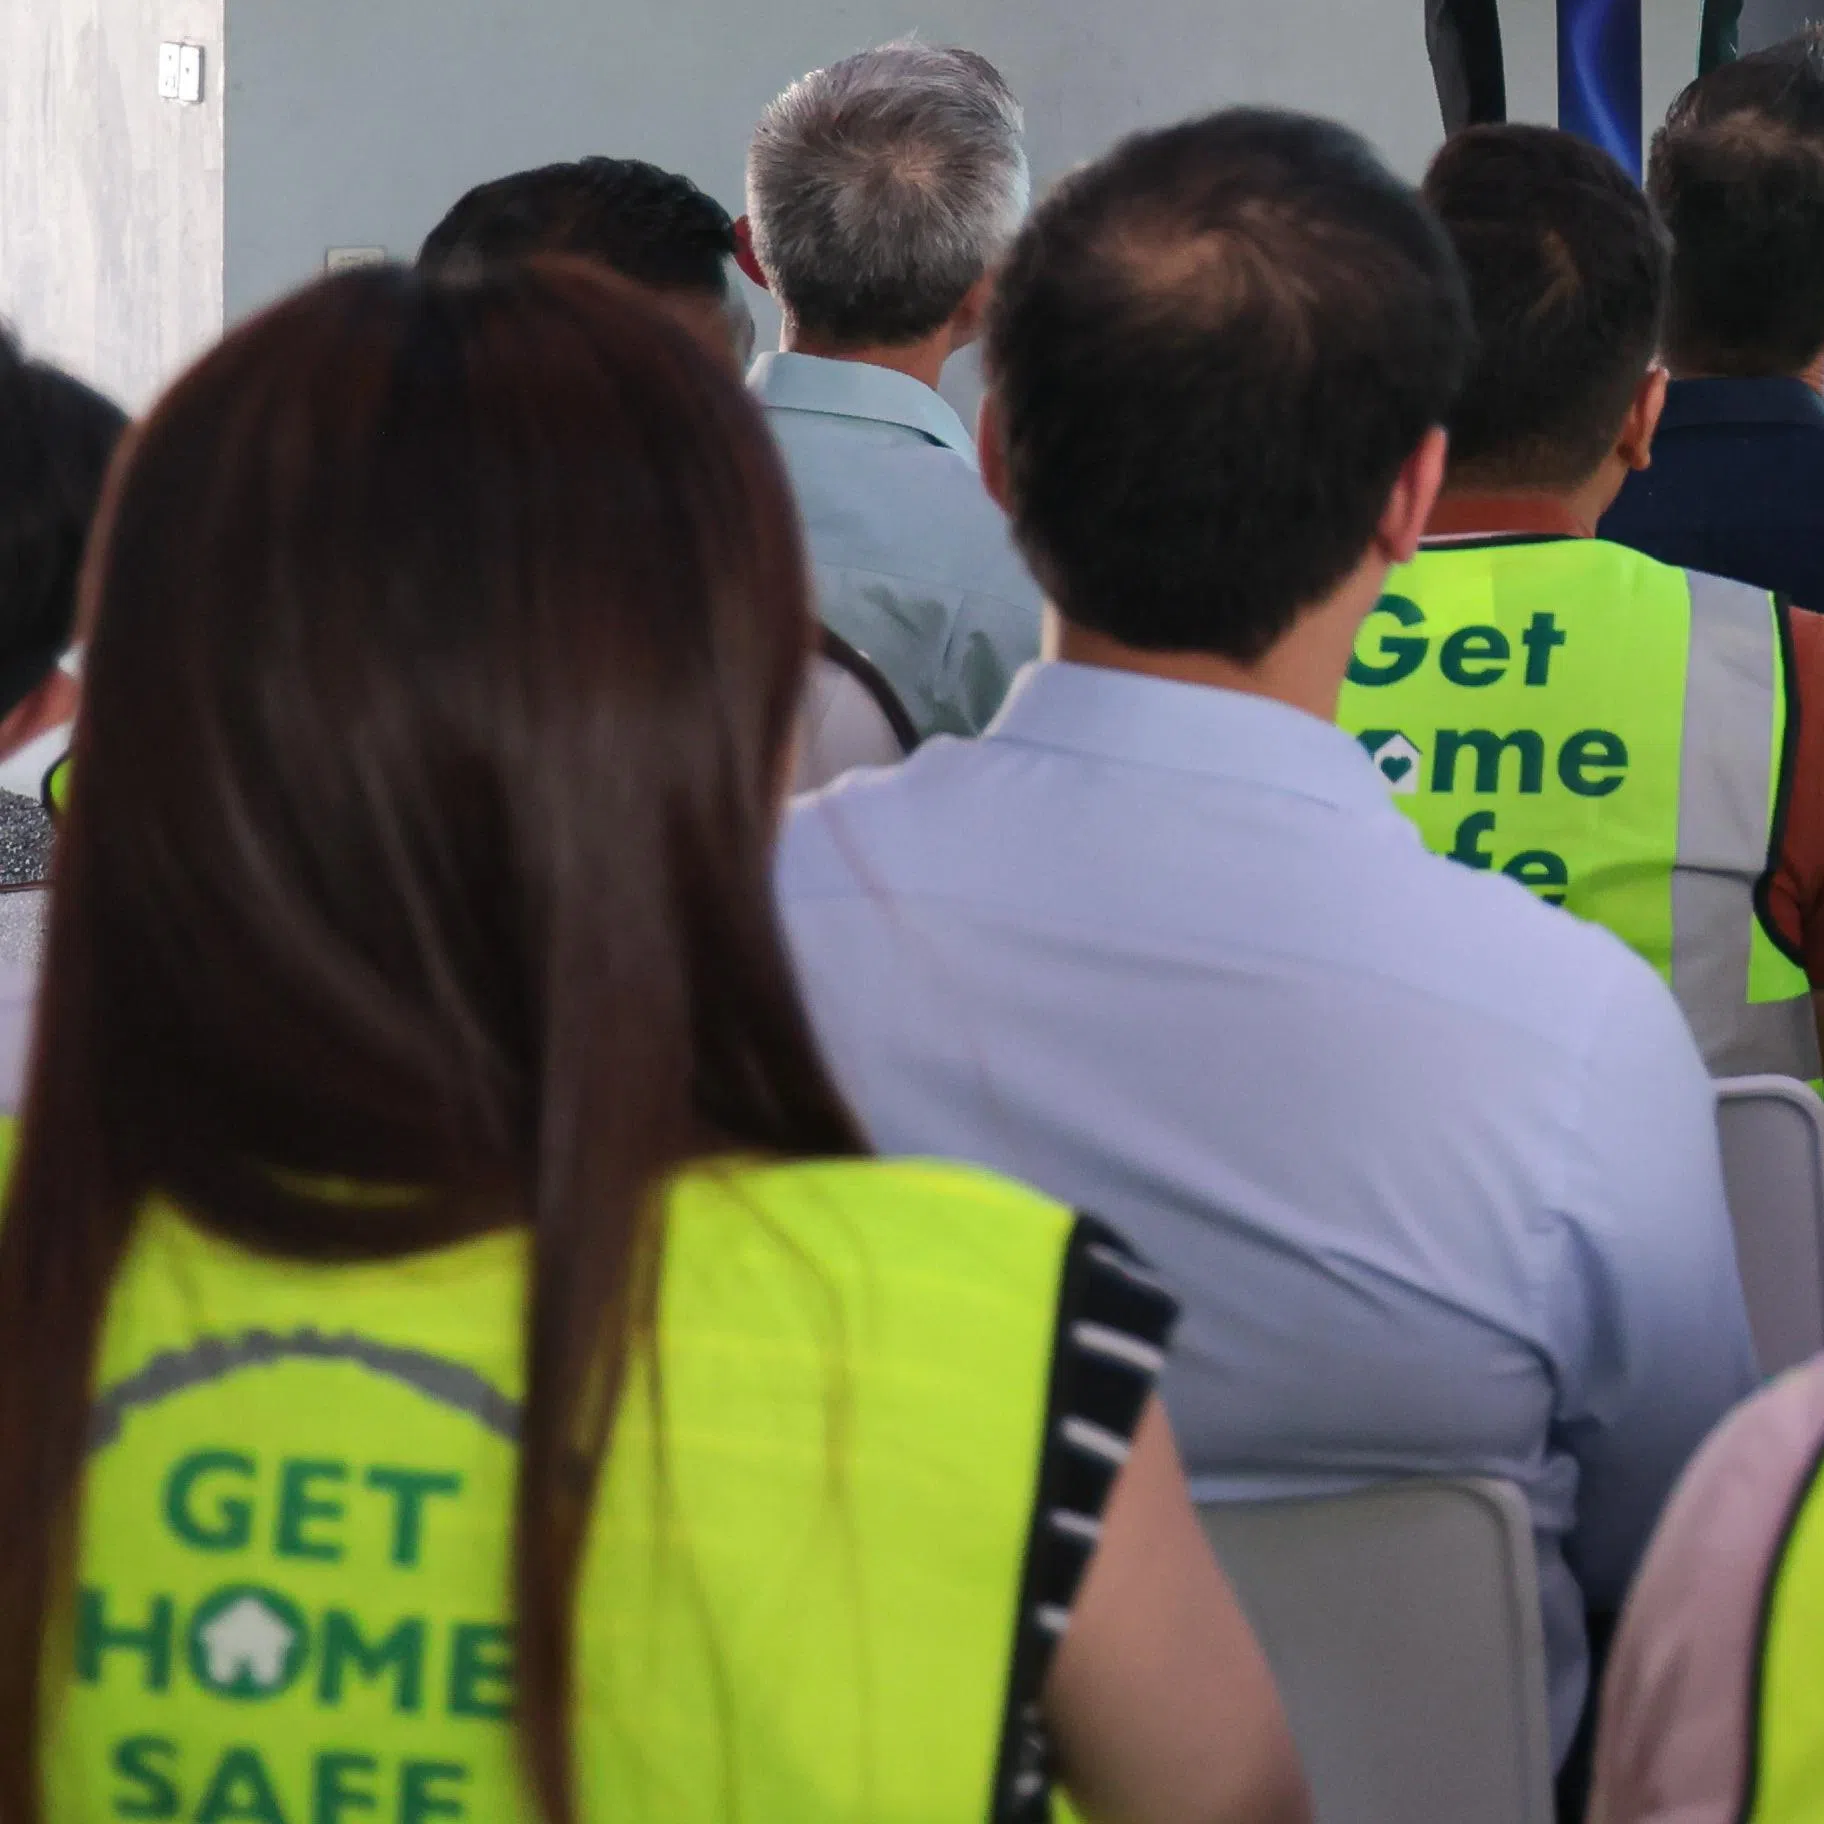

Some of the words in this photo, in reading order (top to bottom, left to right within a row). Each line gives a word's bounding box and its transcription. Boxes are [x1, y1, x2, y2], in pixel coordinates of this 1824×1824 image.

[1344, 593, 1567, 687] Get
[162, 1448, 464, 1570] GET
[74, 1582, 517, 1721] HOME
